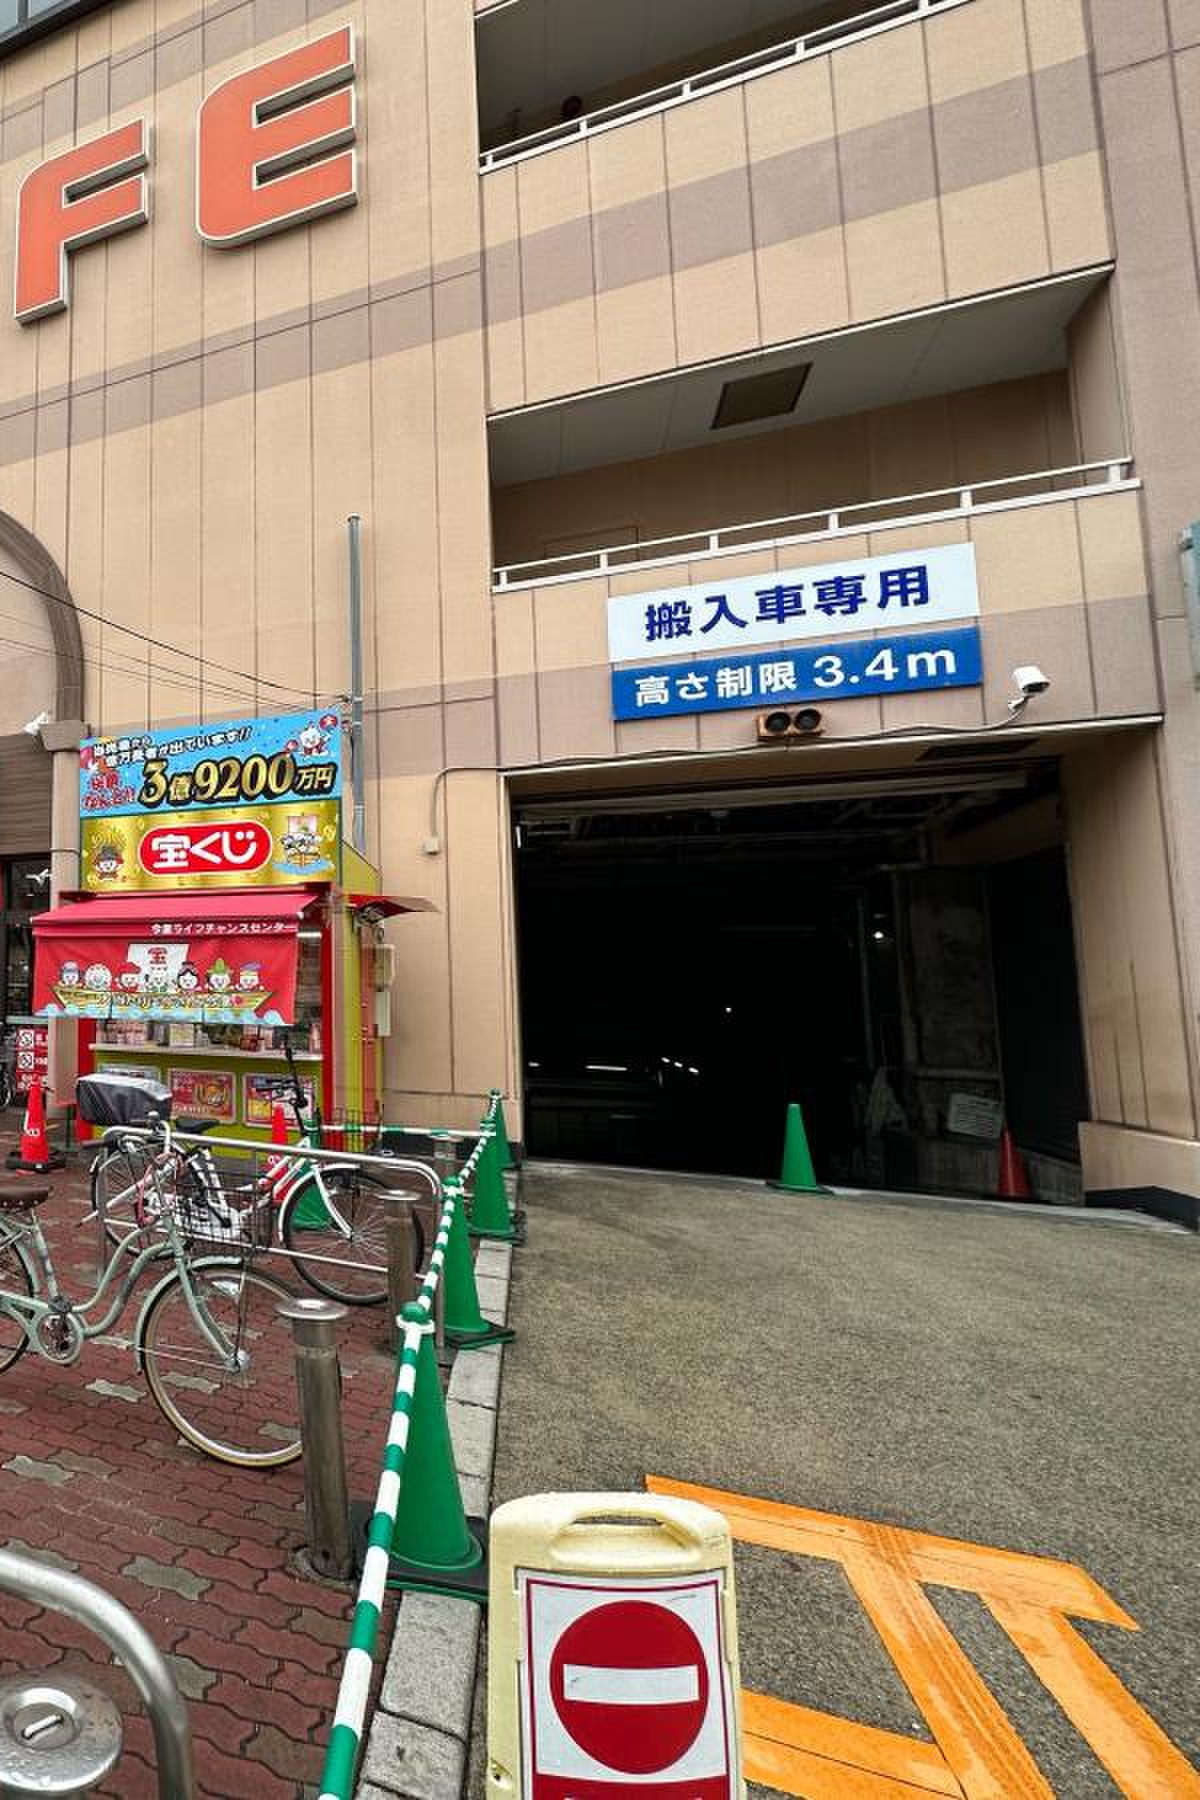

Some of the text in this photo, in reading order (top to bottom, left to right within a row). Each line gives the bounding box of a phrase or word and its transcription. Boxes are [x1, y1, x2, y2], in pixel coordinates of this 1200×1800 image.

[644, 564, 930, 642] 搬入車専用
[634, 647, 957, 707] 高さ制限 3.4m
[140, 754, 335, 807] 3億9200万円
[151, 831, 257, 868] 宝くじ
